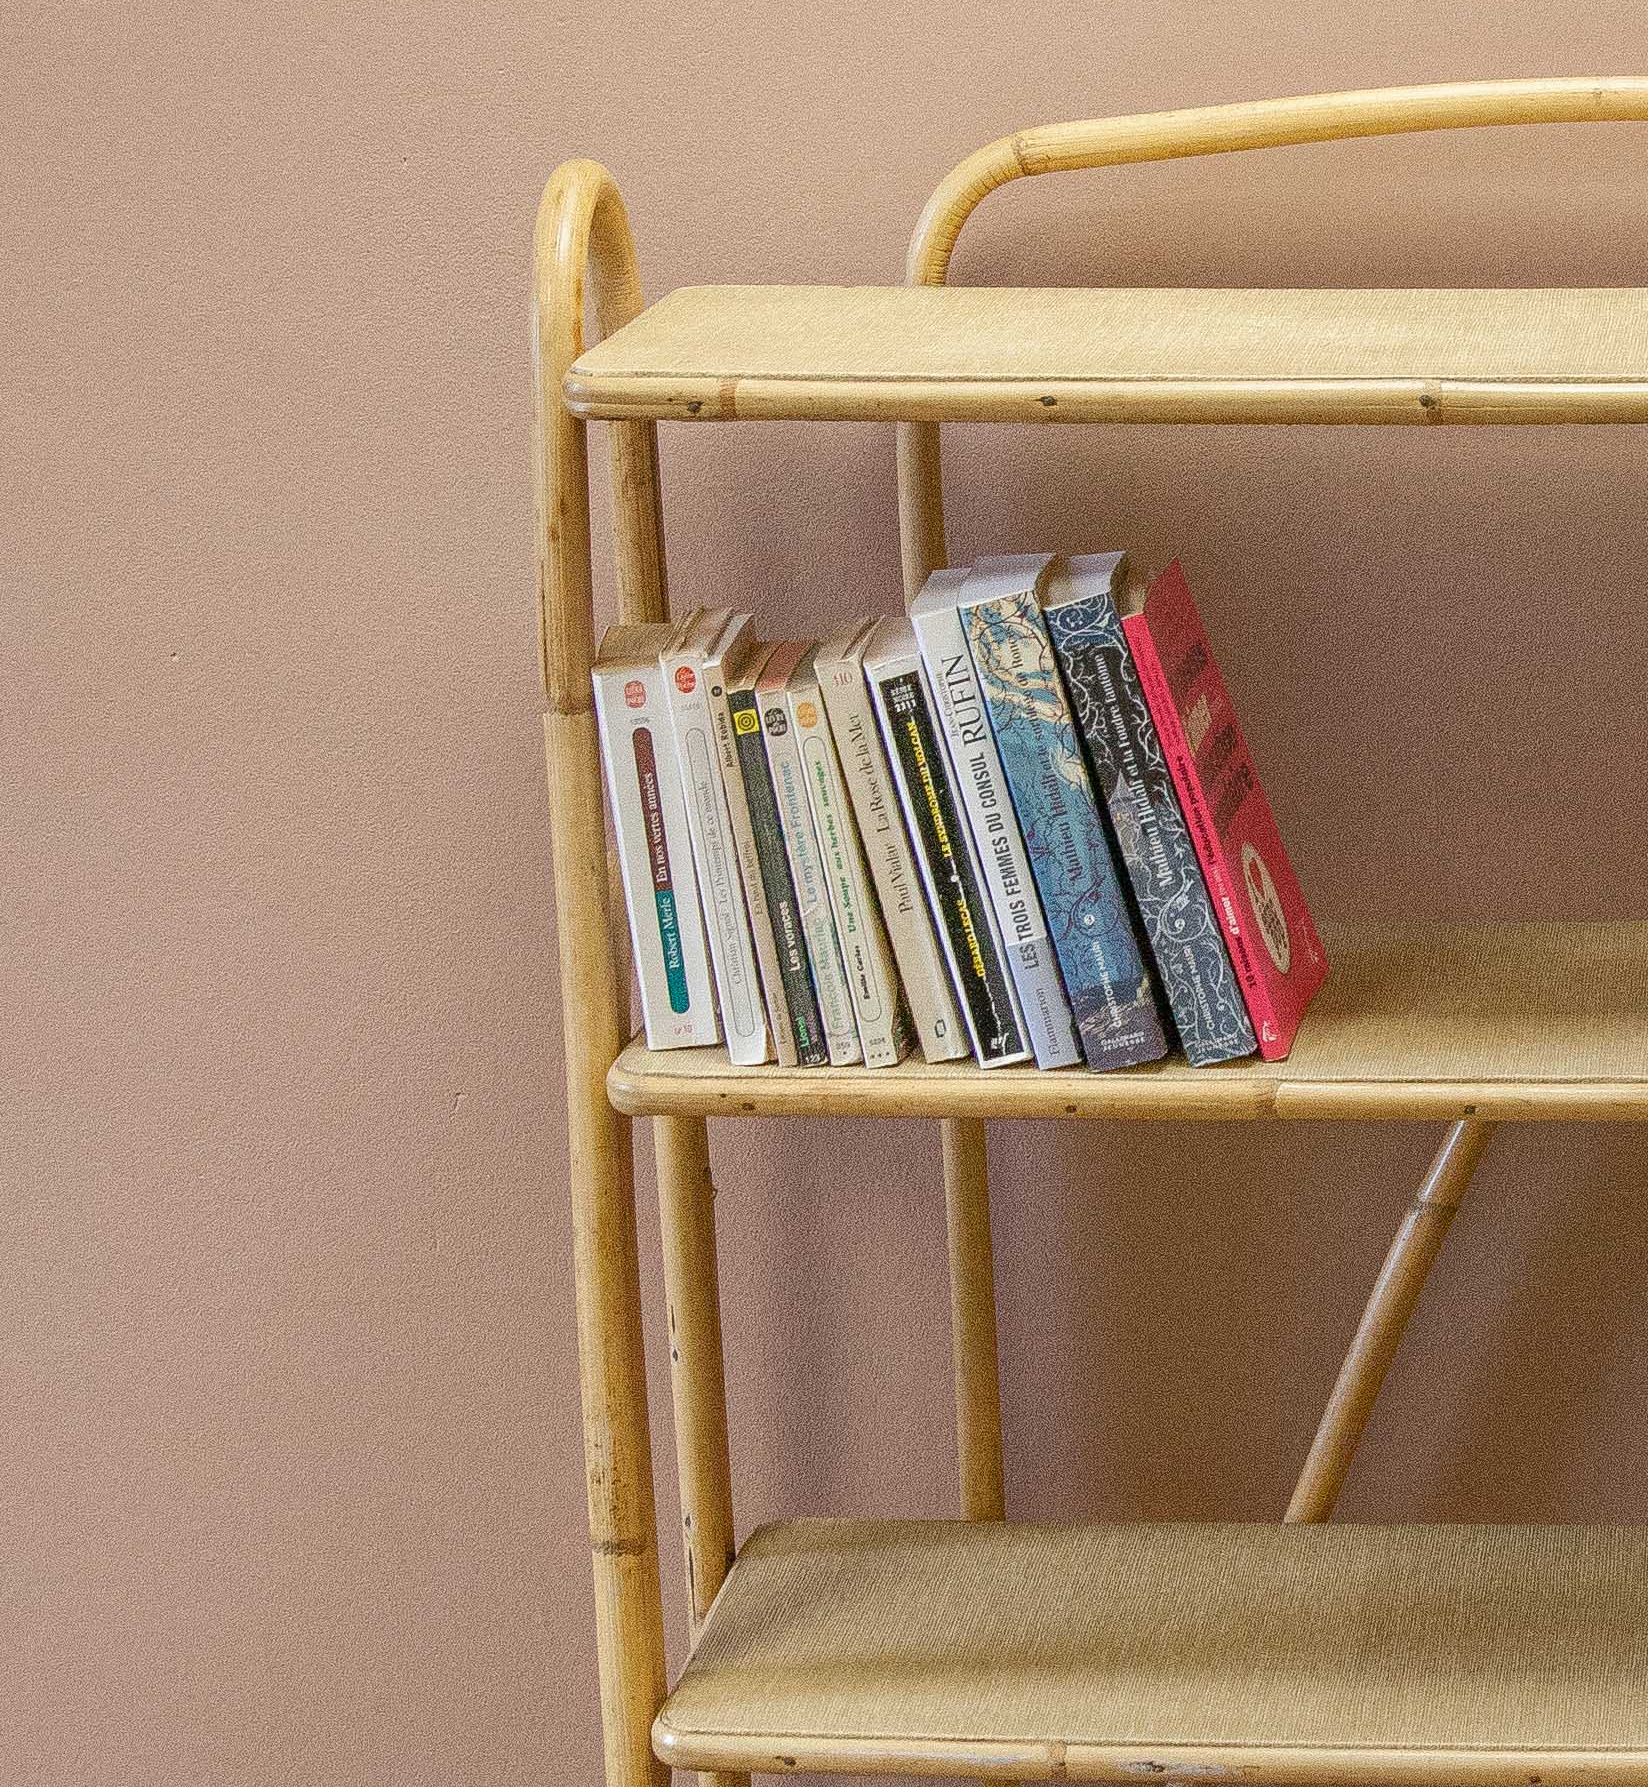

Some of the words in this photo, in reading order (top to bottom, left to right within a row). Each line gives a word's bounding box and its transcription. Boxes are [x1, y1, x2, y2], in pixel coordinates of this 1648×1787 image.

[1001, 623, 1023, 668] Ronces
[1014, 671, 1029, 688] de
[1088, 653, 1117, 704] fantôme
[941, 652, 987, 746] RUFIN
[716, 711, 729, 740] Robida
[845, 711, 866, 743] Mer
[906, 720, 926, 764] VOLCAN
[1105, 703, 1131, 748] Foudre
[721, 742, 734, 768] Albert
[852, 742, 870, 757] la
[856, 756, 875, 776] de
[1033, 741, 1049, 757] le
[1038, 756, 1053, 772] et
[1120, 749, 1135, 763] la
[813, 759, 832, 807] sauvages
[919, 764, 932, 783] DU
[968, 751, 998, 809] CONSUL
[1124, 762, 1139, 777] et
[1174, 754, 1200, 805] populaire
[640, 771, 658, 809] années
[697, 780, 713, 812] monde
[778, 760, 802, 827] Frontenac
[863, 775, 885, 811] Rose
[1039, 772, 1067, 817] Hidalf
[1125, 776, 1156, 825] Hidalf
[647, 811, 664, 844] vertes
[704, 814, 715, 825] ce
[872, 811, 891, 832] La
[924, 783, 948, 842] SYNDROME
[984, 810, 1004, 832] DU
[704, 826, 718, 839] de
[823, 813, 839, 848] herbes
[1189, 805, 1218, 865] l'éducation
[654, 845, 667, 864] nos
[707, 840, 728, 887] Printemps
[792, 830, 817, 884] mystère
[833, 850, 843, 870] aux
[880, 841, 903, 876] Vialar
[940, 843, 952, 857] LE
[991, 834, 1021, 896] FEMMES
[1054, 820, 1084, 882] Mathieu
[1142, 825, 1175, 887] Mathieu
[654, 866, 670, 882] En
[715, 887, 729, 904] Les
[803, 884, 818, 903] Le
[836, 874, 854, 910] Soupe
[891, 881, 914, 913] Paul
[658, 896, 676, 929] Merle
[777, 900, 796, 947] voraces
[844, 911, 857, 932] Une
[1008, 898, 1034, 941] TROIS
[1219, 895, 1241, 935] d'aimer
[663, 932, 682, 968] Robert
[785, 947, 801, 971] Les
[963, 933, 986, 977] GÉRARD
[1018, 942, 1040, 970] LES
[1090, 940, 1107, 974] MAURI
[1181, 943, 1199, 975] MAURI
[1232, 936, 1253, 974] raisons
[1245, 974, 1257, 988] 10
[1099, 974, 1123, 1028] CHRISTOPHE
[1192, 977, 1217, 1030] CHRISTOPHE
[1032, 986, 1061, 1056] Flammarion
